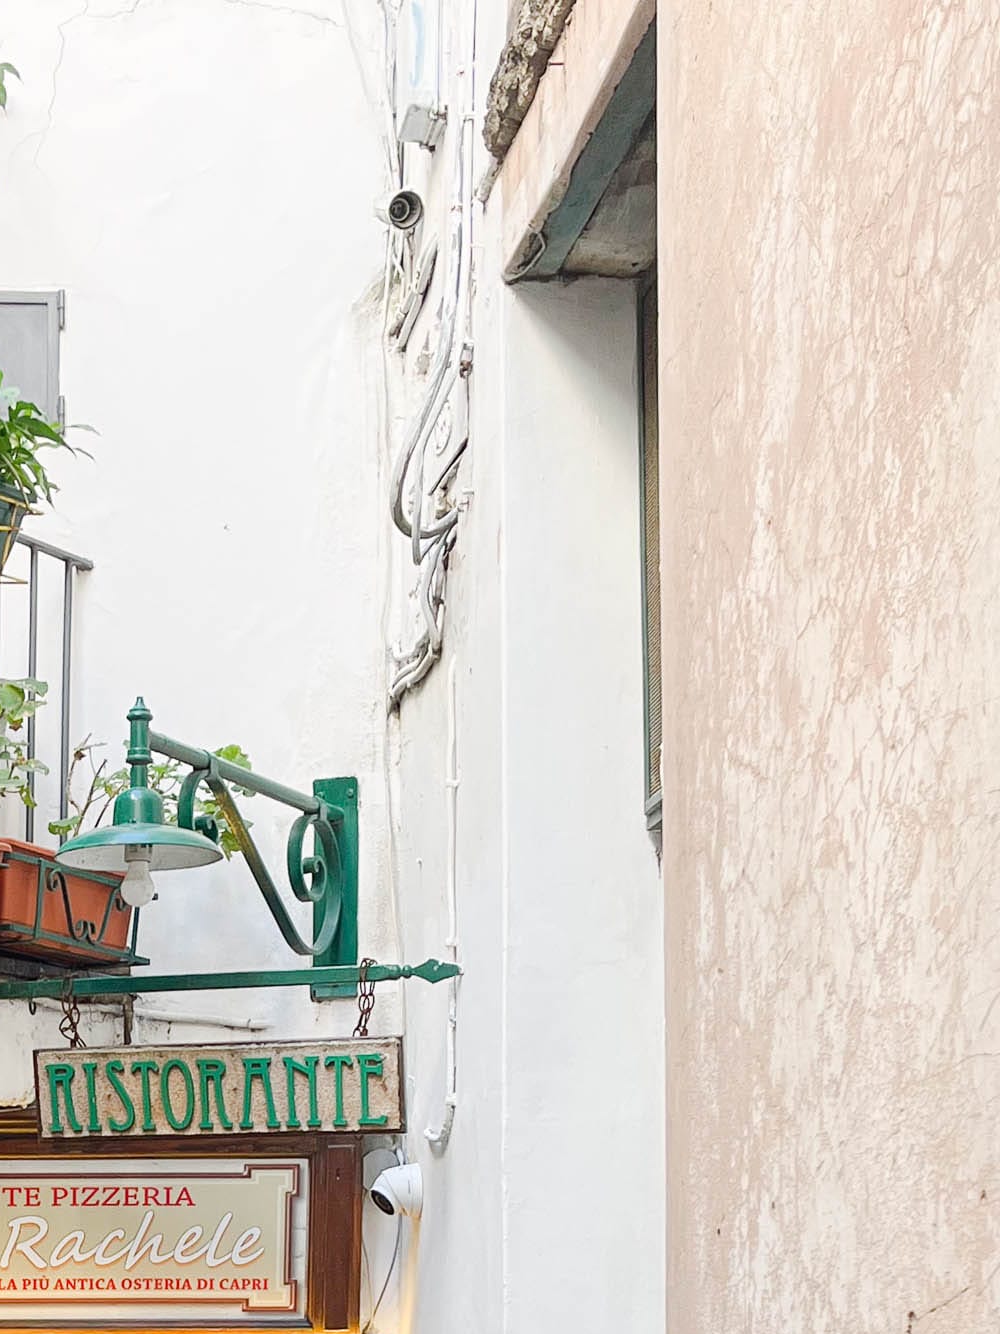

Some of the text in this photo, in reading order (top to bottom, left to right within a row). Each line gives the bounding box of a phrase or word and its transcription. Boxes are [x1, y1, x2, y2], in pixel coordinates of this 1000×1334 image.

[45, 1053, 388, 1133] RISTORANTE
[51, 1186, 195, 1207] PIZZERIA
[0, 1211, 265, 1271] Rachele
[22, 1275, 49, 1290] PIÙ
[53, 1278, 118, 1290] ANTICA
[121, 1278, 192, 1290] OSTERIA
[197, 1278, 214, 1290] DI
[219, 1278, 269, 1290] CAPRI
